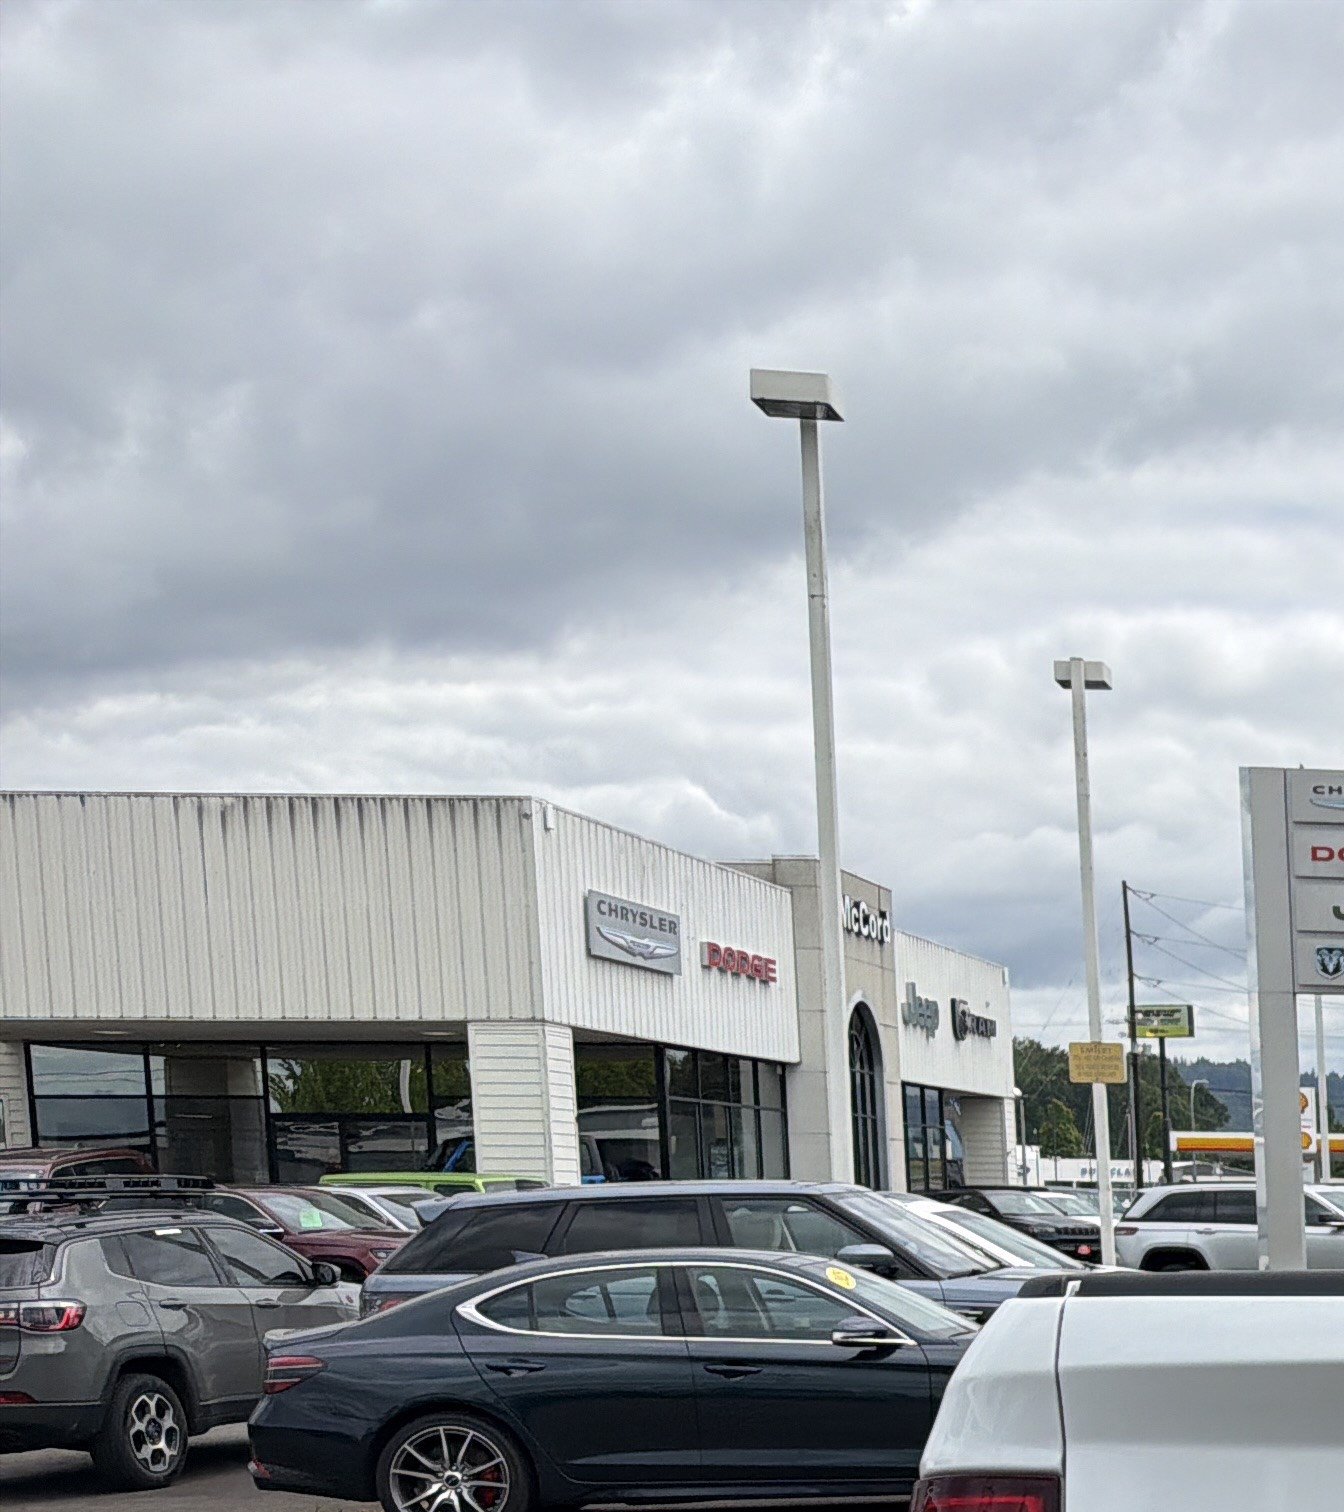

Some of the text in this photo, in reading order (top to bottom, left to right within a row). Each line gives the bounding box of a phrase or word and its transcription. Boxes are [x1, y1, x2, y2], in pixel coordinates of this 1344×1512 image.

[596, 899, 678, 936] CHRYSLER
[704, 941, 777, 984] DODGE
[901, 981, 940, 1041] Jeep
